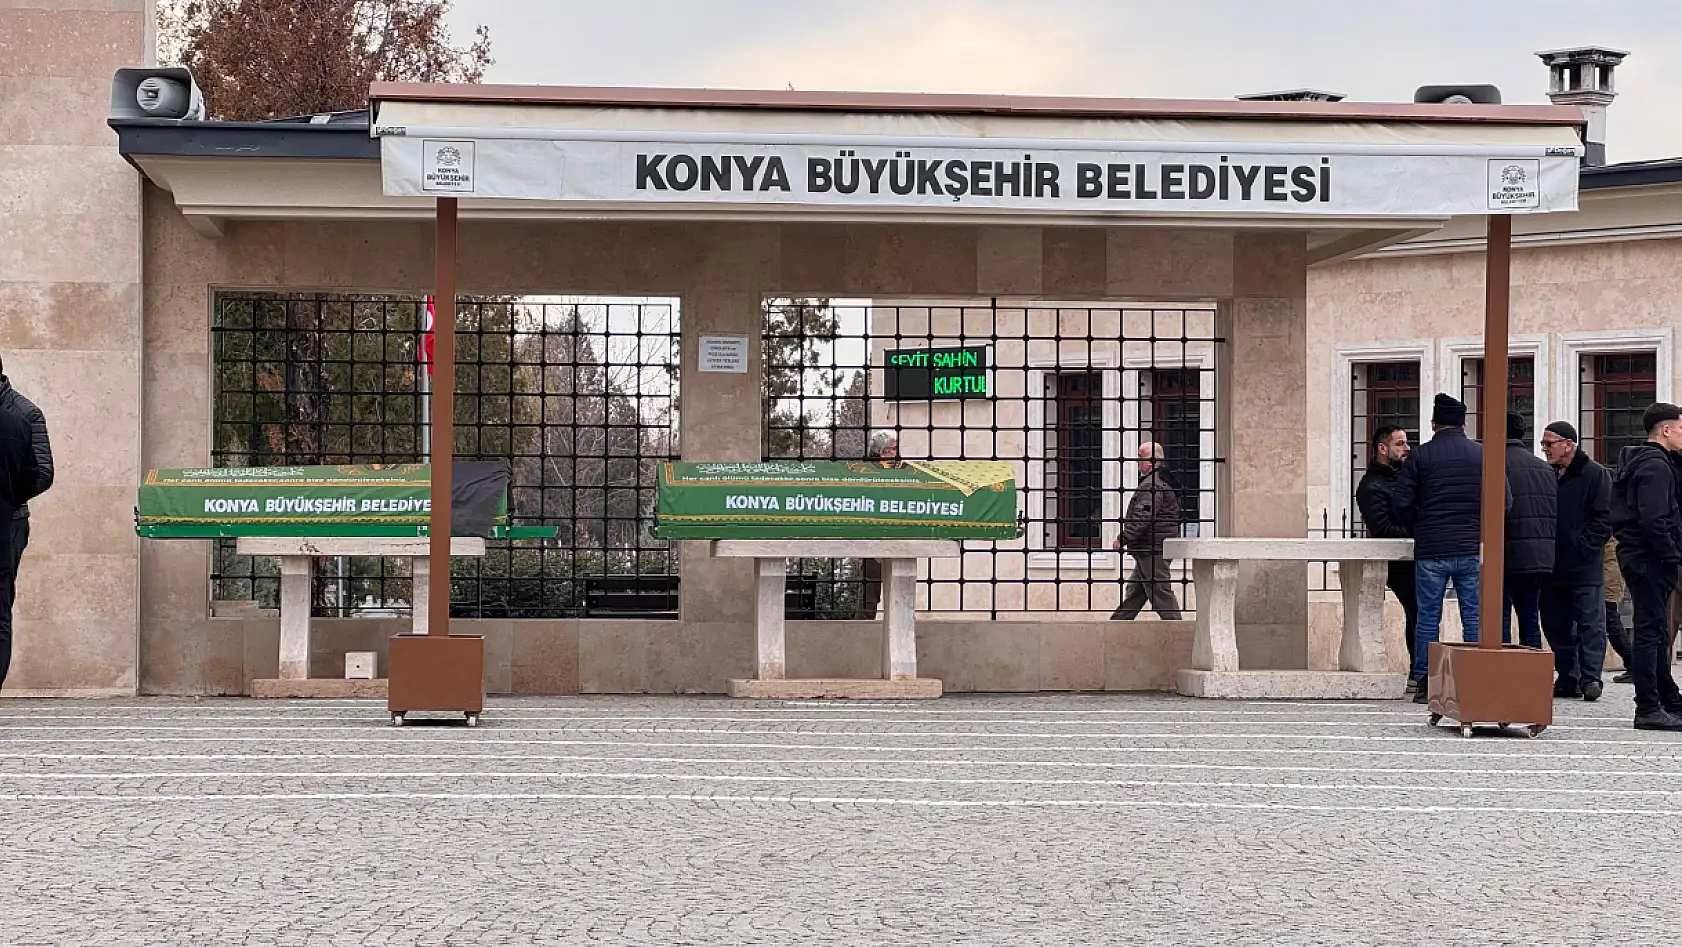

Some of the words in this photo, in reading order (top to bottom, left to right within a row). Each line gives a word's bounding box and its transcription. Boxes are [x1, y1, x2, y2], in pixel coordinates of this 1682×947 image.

[636, 154, 791, 192] KONYA
[807, 150, 1060, 202] BÜYÜKŞEHİR
[1076, 156, 1331, 203] BELEDİYESİ
[204, 499, 259, 513] KONYA
[265, 496, 356, 514] BÜYÜKŞEHİR
[360, 496, 432, 512] BELEDİYE
[725, 495, 780, 510] KONYA
[785, 494, 875, 514] BÜYÜKŞEHİR
[879, 499, 964, 516] BELEDİYESİ
